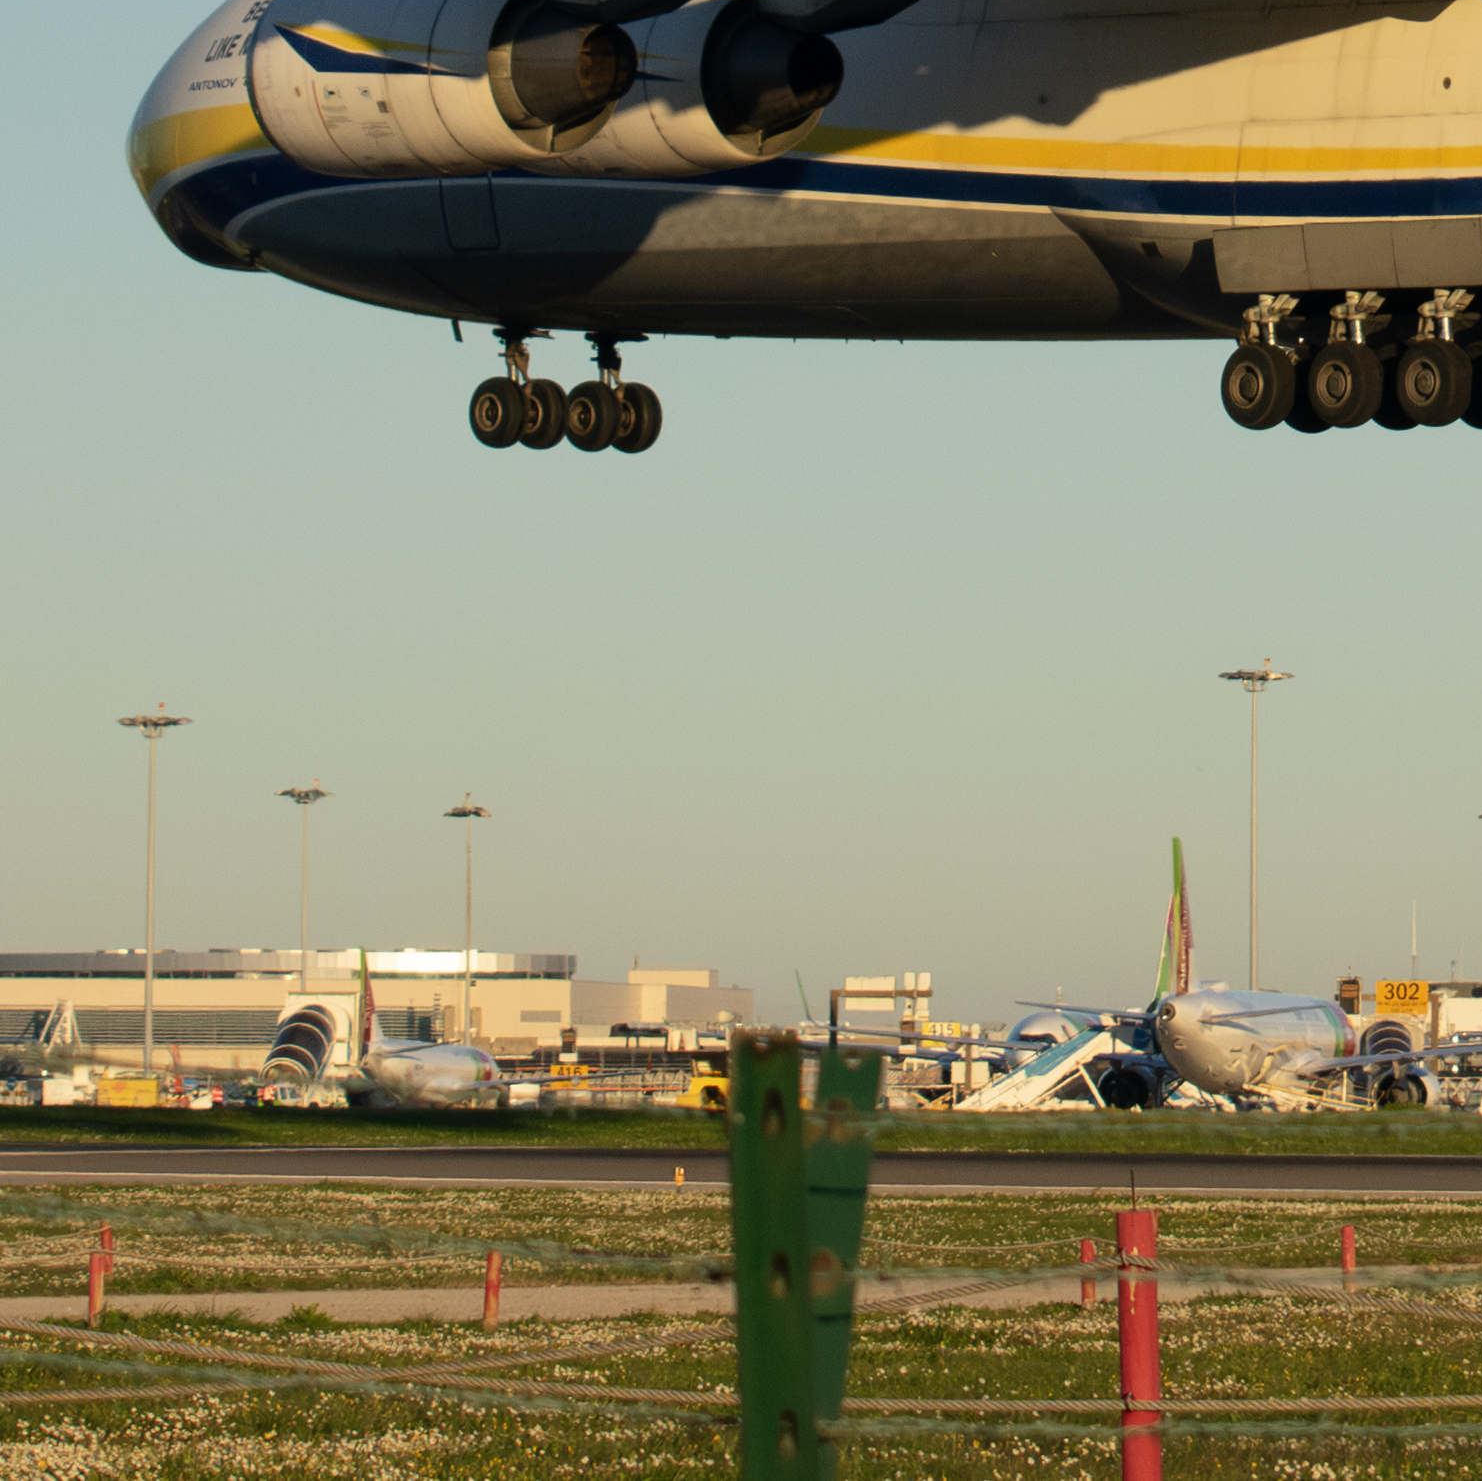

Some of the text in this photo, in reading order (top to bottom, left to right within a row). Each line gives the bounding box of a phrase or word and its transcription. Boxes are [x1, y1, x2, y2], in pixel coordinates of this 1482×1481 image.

[204, 34, 242, 63] LIKE
[188, 78, 239, 91] ANTONOV
[1384, 983, 1420, 1000] 302
[928, 1023, 954, 1036] 415
[557, 1066, 582, 1076] 416
